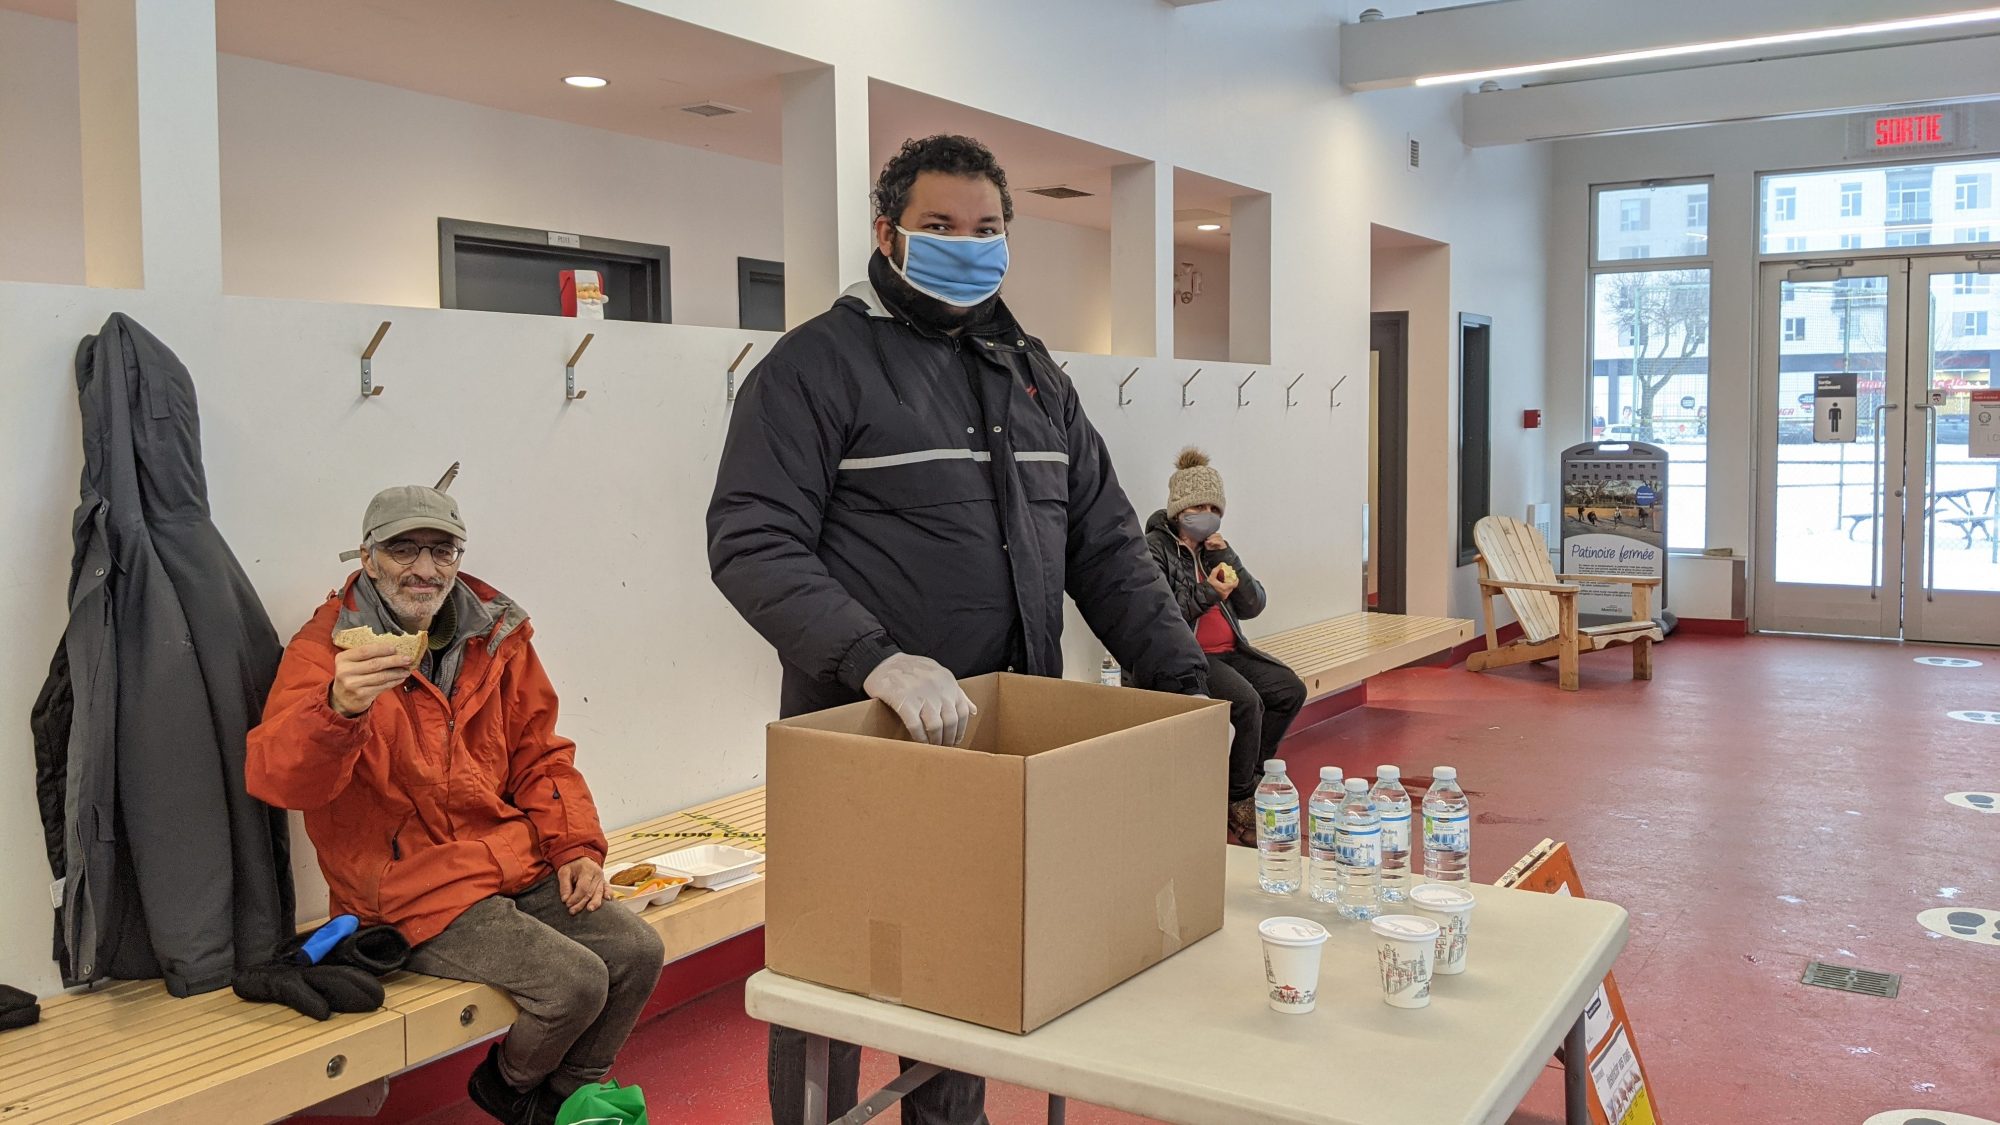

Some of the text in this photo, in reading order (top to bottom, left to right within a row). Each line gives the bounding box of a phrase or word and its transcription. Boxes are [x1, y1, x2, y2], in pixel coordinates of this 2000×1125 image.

[1875, 114, 1944, 146] SORTIE
[1571, 544, 1655, 562] Patinoire fermée
